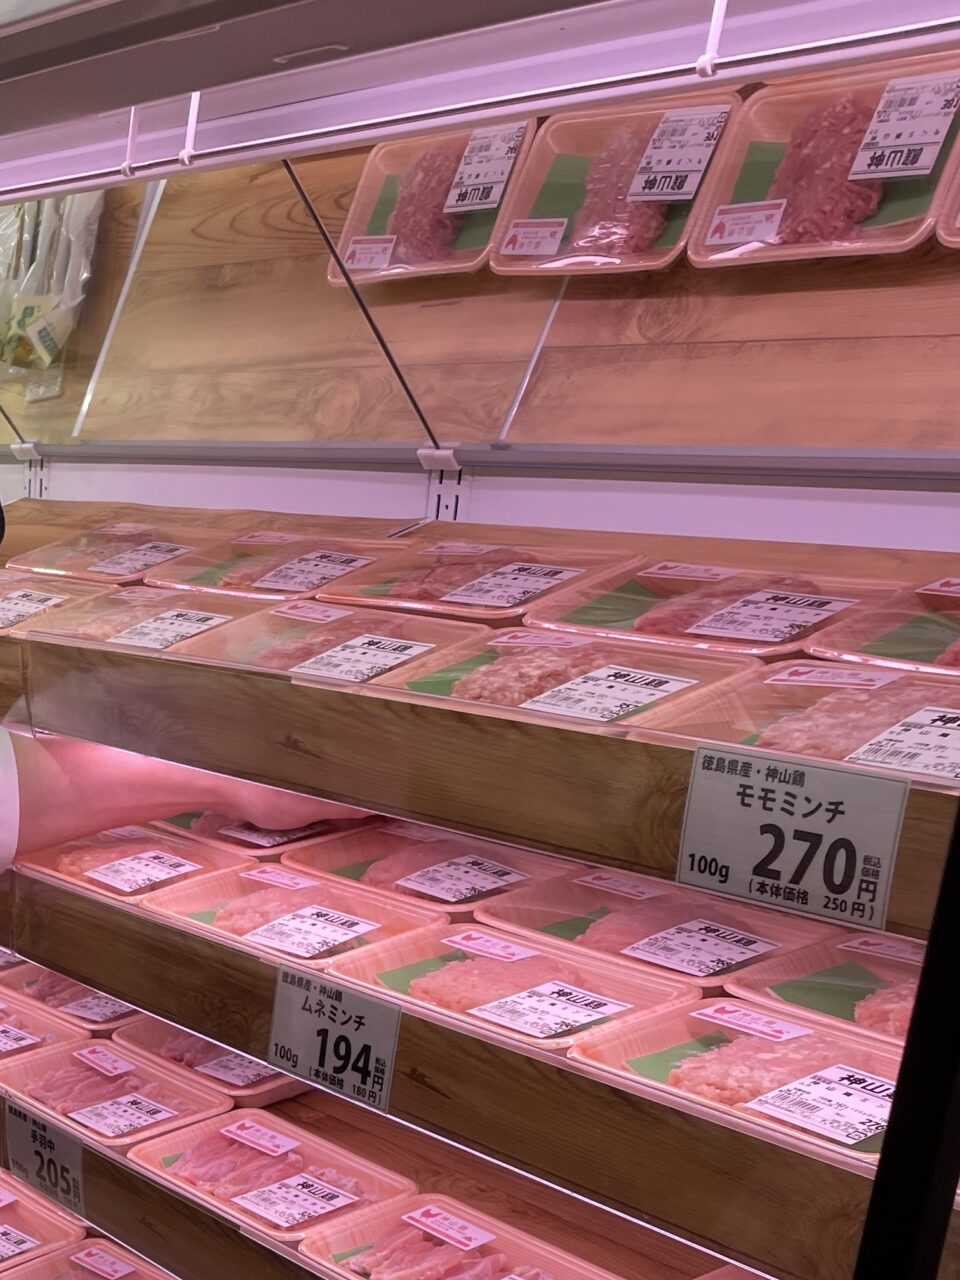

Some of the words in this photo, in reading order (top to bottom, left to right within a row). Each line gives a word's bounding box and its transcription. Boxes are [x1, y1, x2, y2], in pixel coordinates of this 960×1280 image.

[764, 593, 832, 609] 神山鶏
[362, 638, 413, 652] 神山鶏
[606, 671, 670, 688] 神山鶏
[701, 755, 805, 788] 徳島県産・神山鶏
[736, 784, 845, 823] モモミンチ
[688, 853, 730, 884] 100g
[752, 823, 857, 895] 270
[857, 879, 877, 902] 円
[697, 925, 760, 947] 神山鶏
[548, 988, 608, 1010] 神山鶏
[302, 995, 365, 1031] ムネミンチ
[274, 1043, 298, 1068] 100g
[316, 1028, 371, 1085] 194
[34, 1149, 71, 1196] 205
[295, 1180, 340, 1202] 神山鶏
